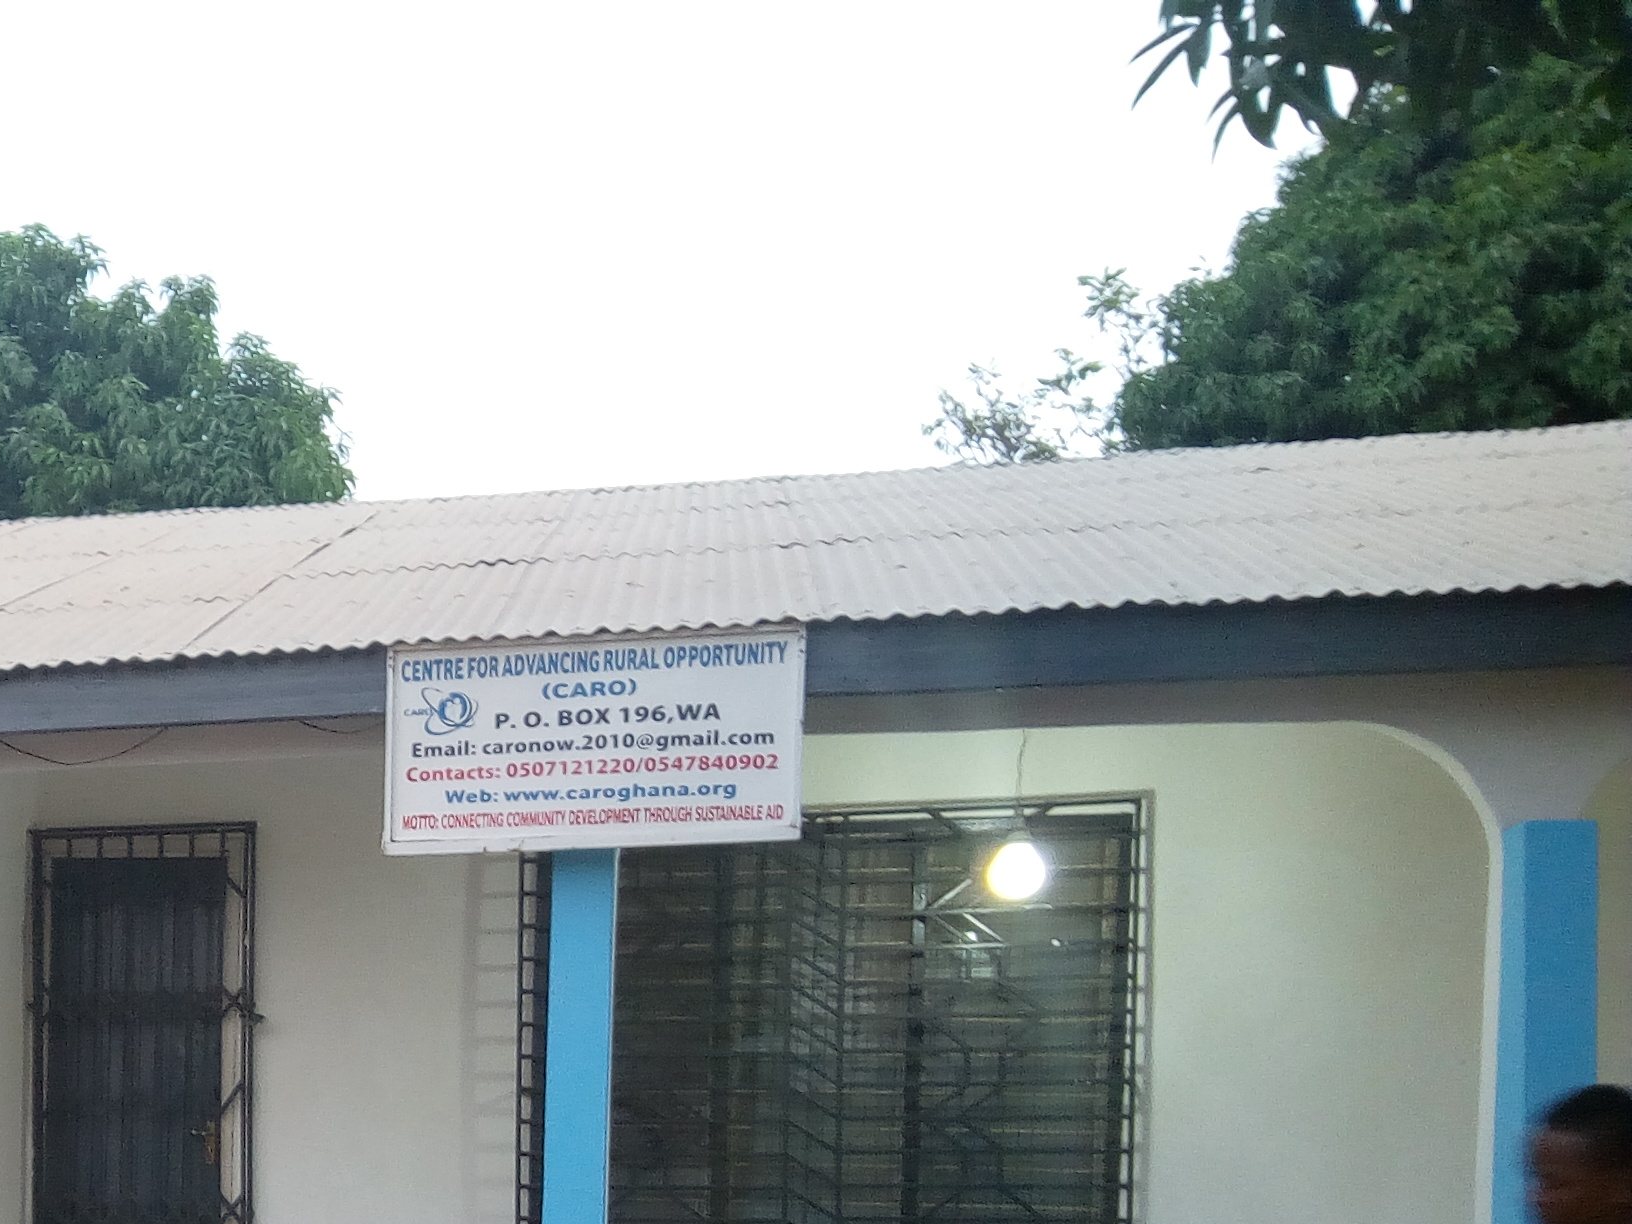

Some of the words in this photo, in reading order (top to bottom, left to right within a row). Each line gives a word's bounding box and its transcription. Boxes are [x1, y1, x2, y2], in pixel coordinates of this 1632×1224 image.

[401, 657, 464, 682] CENTRE
[468, 655, 499, 679] FOR
[501, 650, 600, 677] ADVANCING
[603, 647, 660, 672] RURAL
[664, 640, 788, 669] OPPORTUNITY
[542, 678, 637, 700] (CARO)
[495, 713, 516, 730] P.
[523, 711, 550, 728] O.
[558, 707, 611, 727] BOX
[619, 702, 721, 725] 196,WA
[411, 740, 477, 758] Email:
[482, 729, 775, 755] caronow.2010@gmail.com
[406, 766, 501, 783] Contacts:
[506, 753, 779, 778] 0507121220/0547840902
[444, 788, 498, 804] Web:
[503, 783, 737, 803] www.caroghana.org
[402, 813, 439, 830] MOTTO:
[441, 811, 504, 829] CONNECTING
[506, 809, 566, 827] COMMUNITY
[568, 807, 641, 825] DEVELOPMENT
[644, 805, 693, 823] THROUGH
[695, 804, 763, 822] SUSTAINABLE
[766, 803, 784, 820] AID
